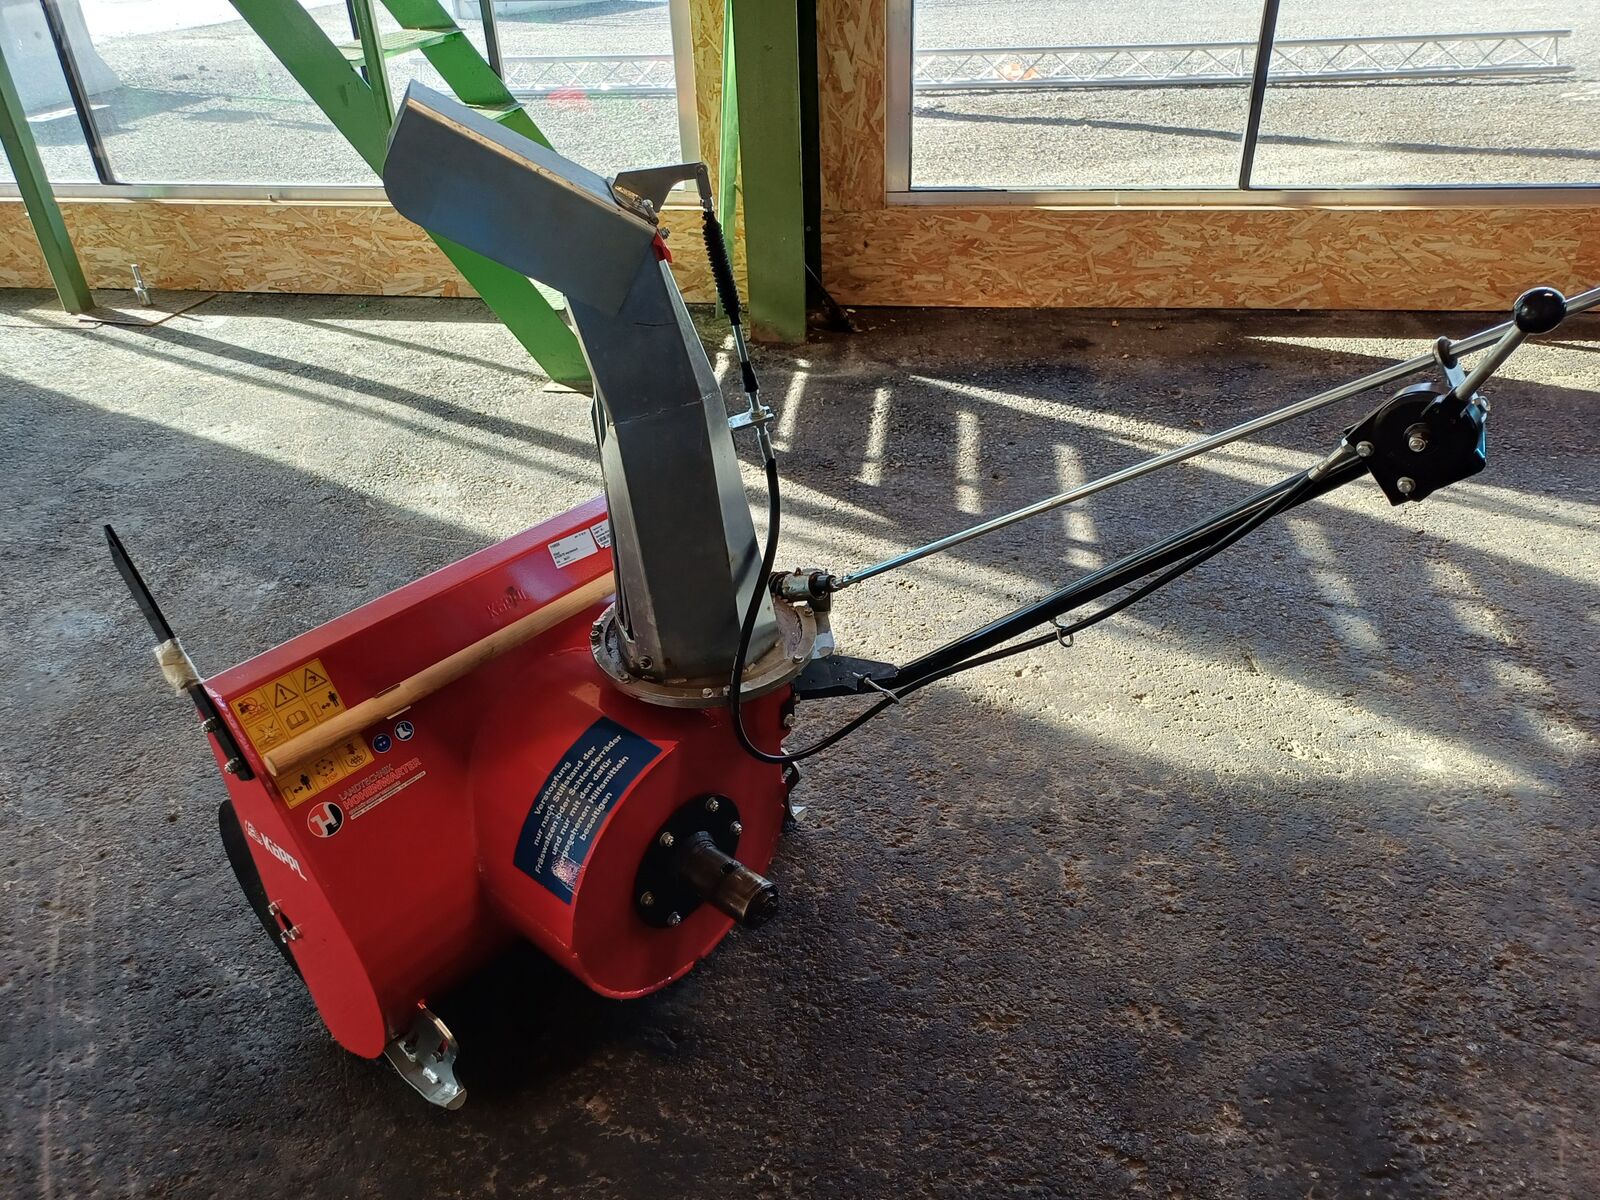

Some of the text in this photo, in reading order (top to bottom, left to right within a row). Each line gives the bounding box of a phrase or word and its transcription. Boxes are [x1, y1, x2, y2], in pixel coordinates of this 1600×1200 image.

[339, 764, 394, 800] LANDTECHNIK
[342, 757, 422, 810] HOHENWARTER
[534, 761, 572, 815] Verstopfung
[534, 745, 597, 846] nur nach Stillstand der
[535, 735, 622, 874] Fräswalzen oder Schleuderräder
[552, 758, 612, 856] und nur mit den dafür
[557, 755, 629, 871] orgesehenen Hilfsmitteln
[579, 792, 613, 841] beseitigen
